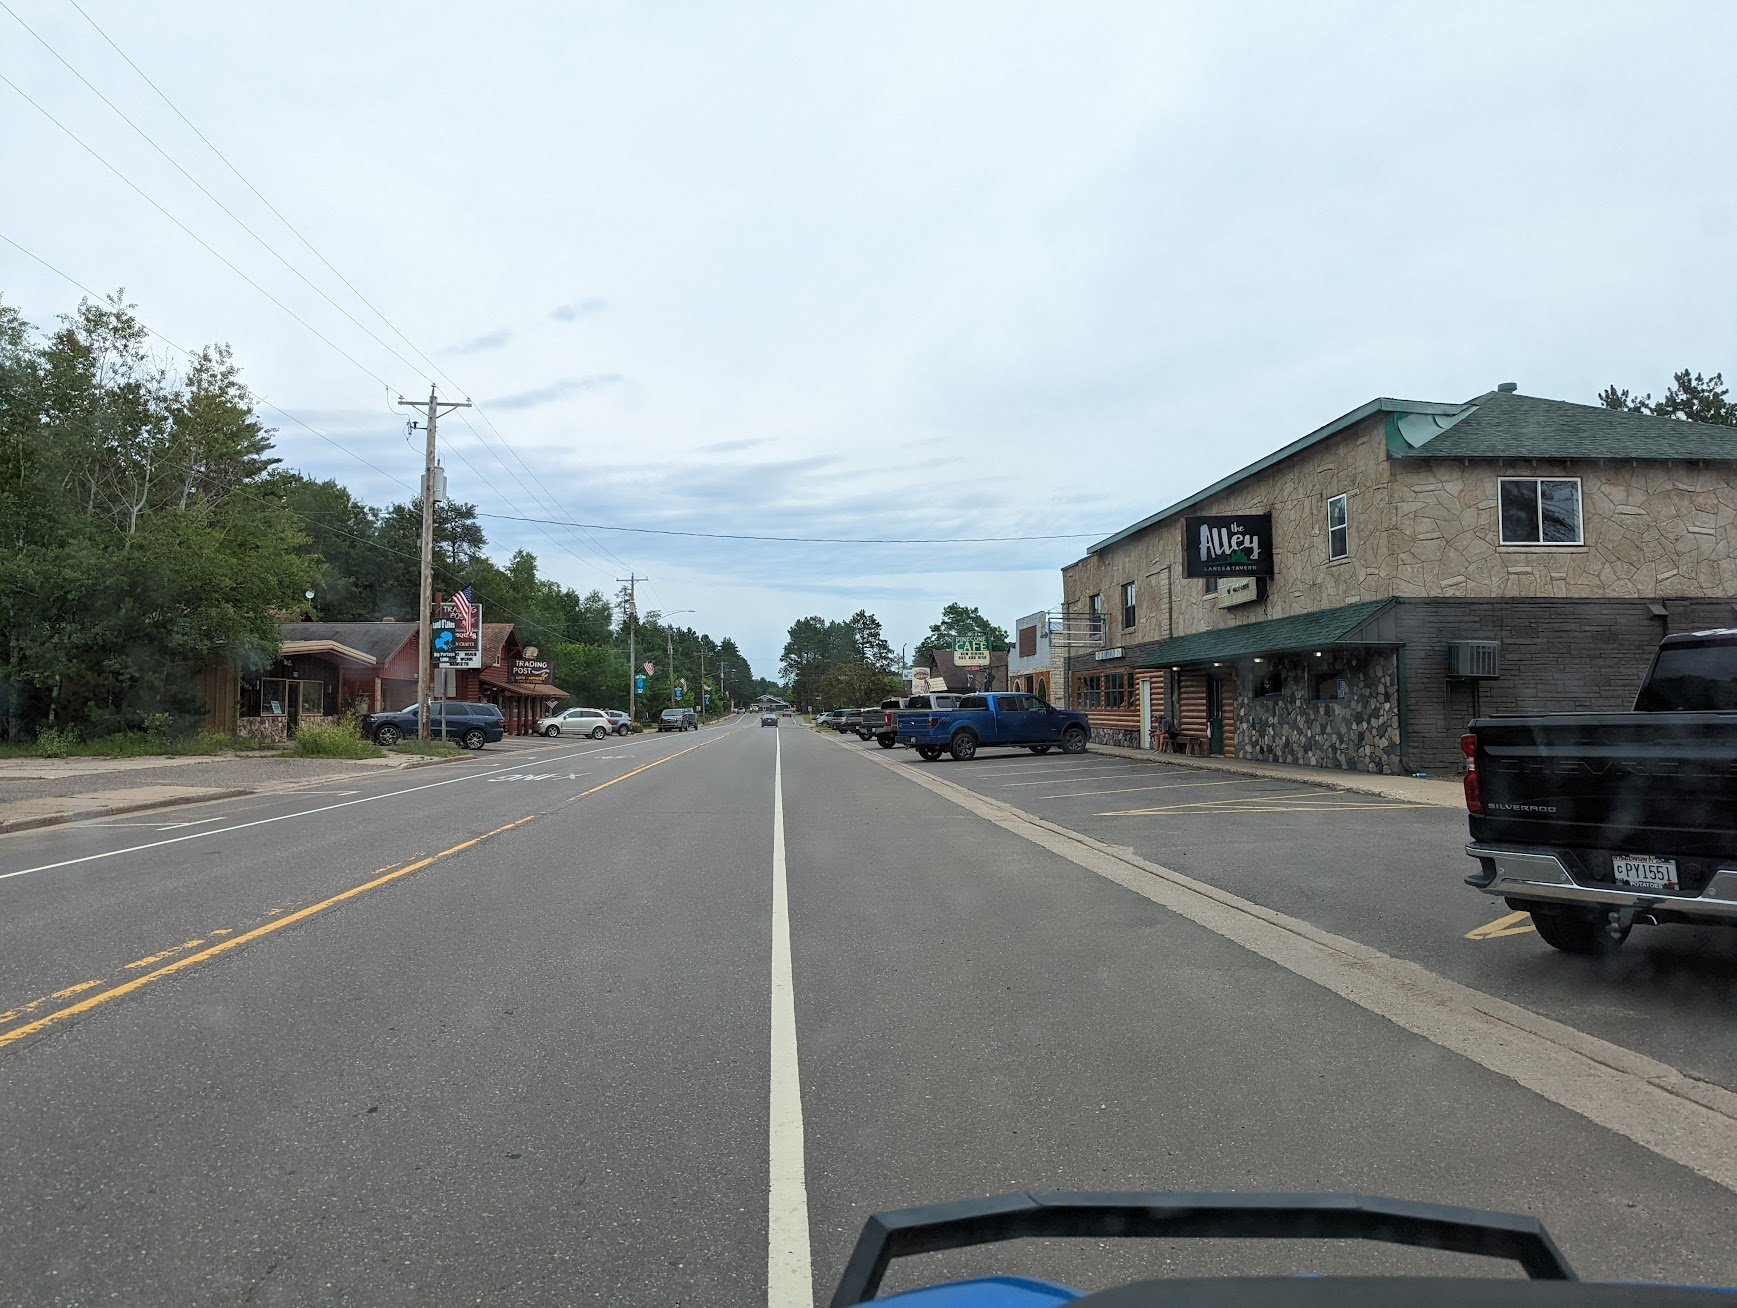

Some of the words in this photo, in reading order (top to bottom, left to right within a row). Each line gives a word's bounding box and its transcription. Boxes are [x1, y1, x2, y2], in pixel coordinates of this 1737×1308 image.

[1230, 522, 1245, 532] the
[1199, 524, 1261, 561] Alley
[955, 641, 988, 651] CAFE
[515, 660, 548, 668] TRADING
[1487, 803, 1557, 813] SILVERADO
[1625, 862, 1672, 882] PY1551
[1630, 881, 1663, 889] POTATOES
